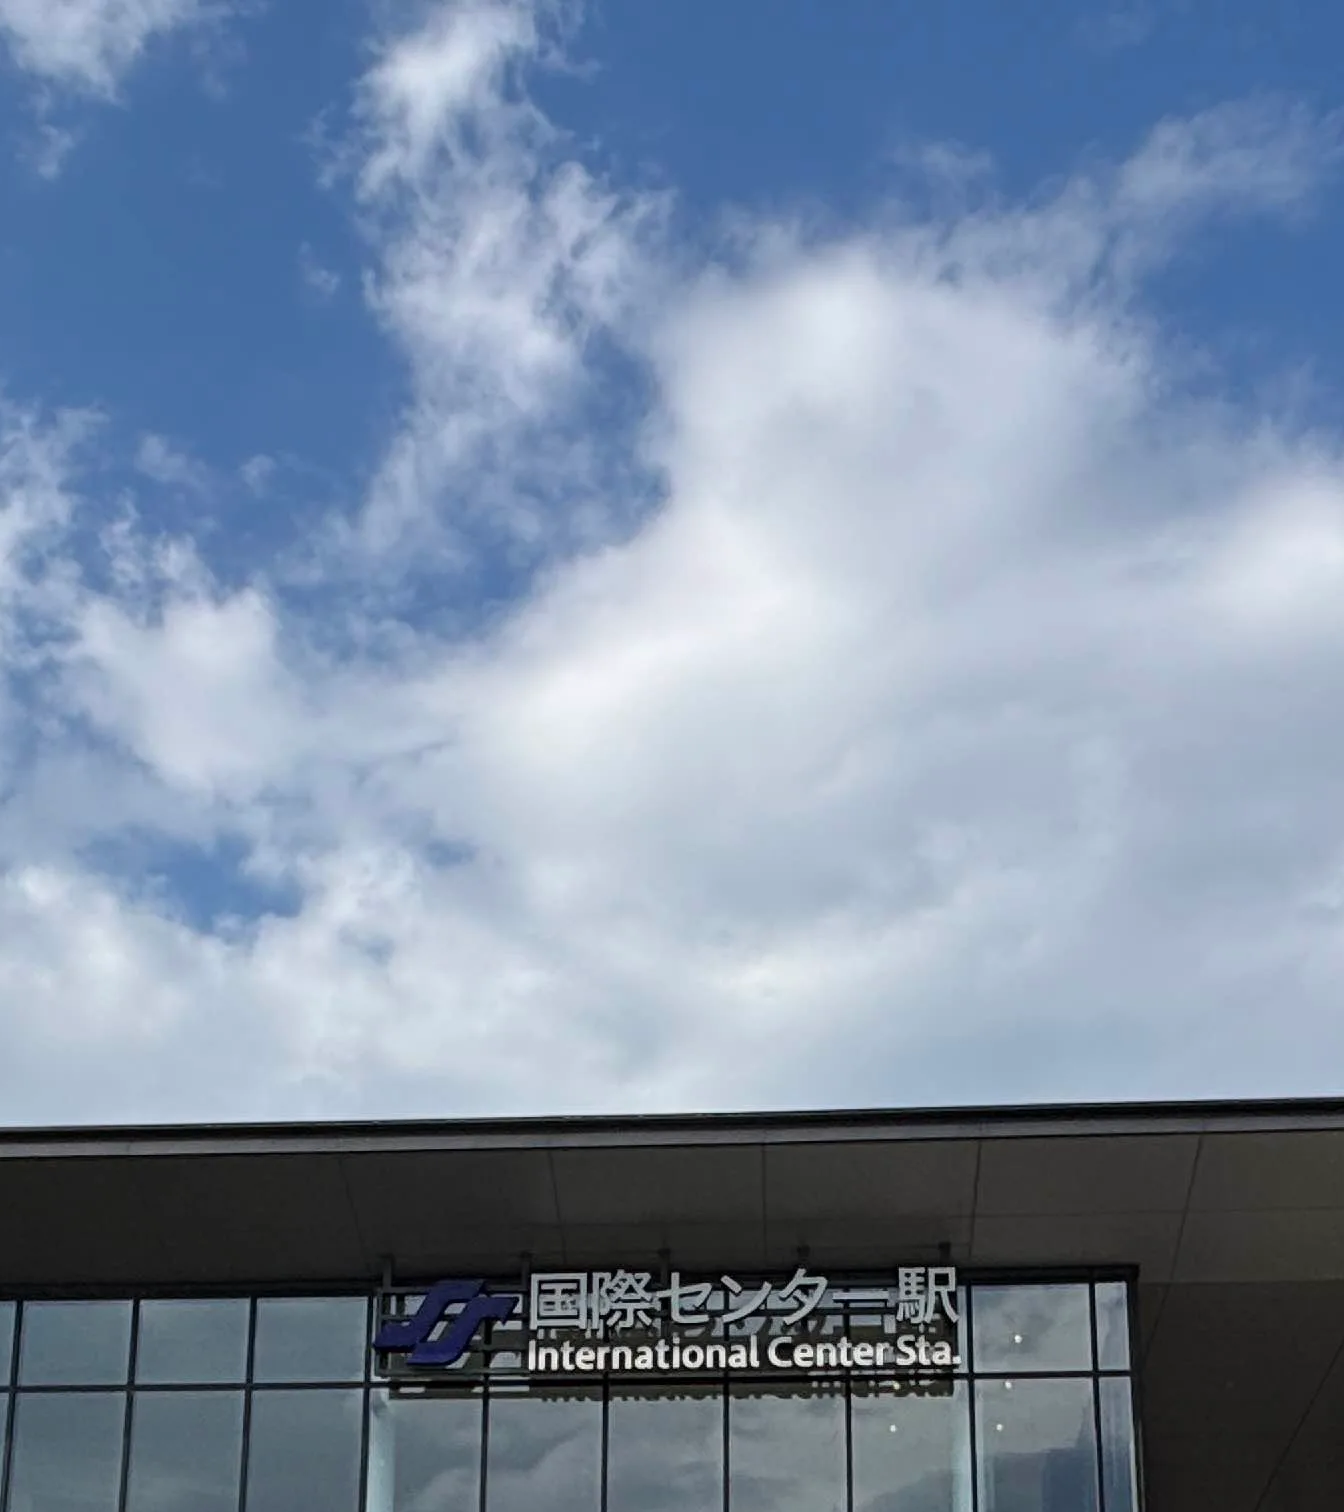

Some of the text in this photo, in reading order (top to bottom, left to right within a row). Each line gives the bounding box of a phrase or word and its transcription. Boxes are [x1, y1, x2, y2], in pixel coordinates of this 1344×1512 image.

[529, 1267, 960, 1330] 国際センター駅
[528, 1334, 962, 1371] International Center Sta.
